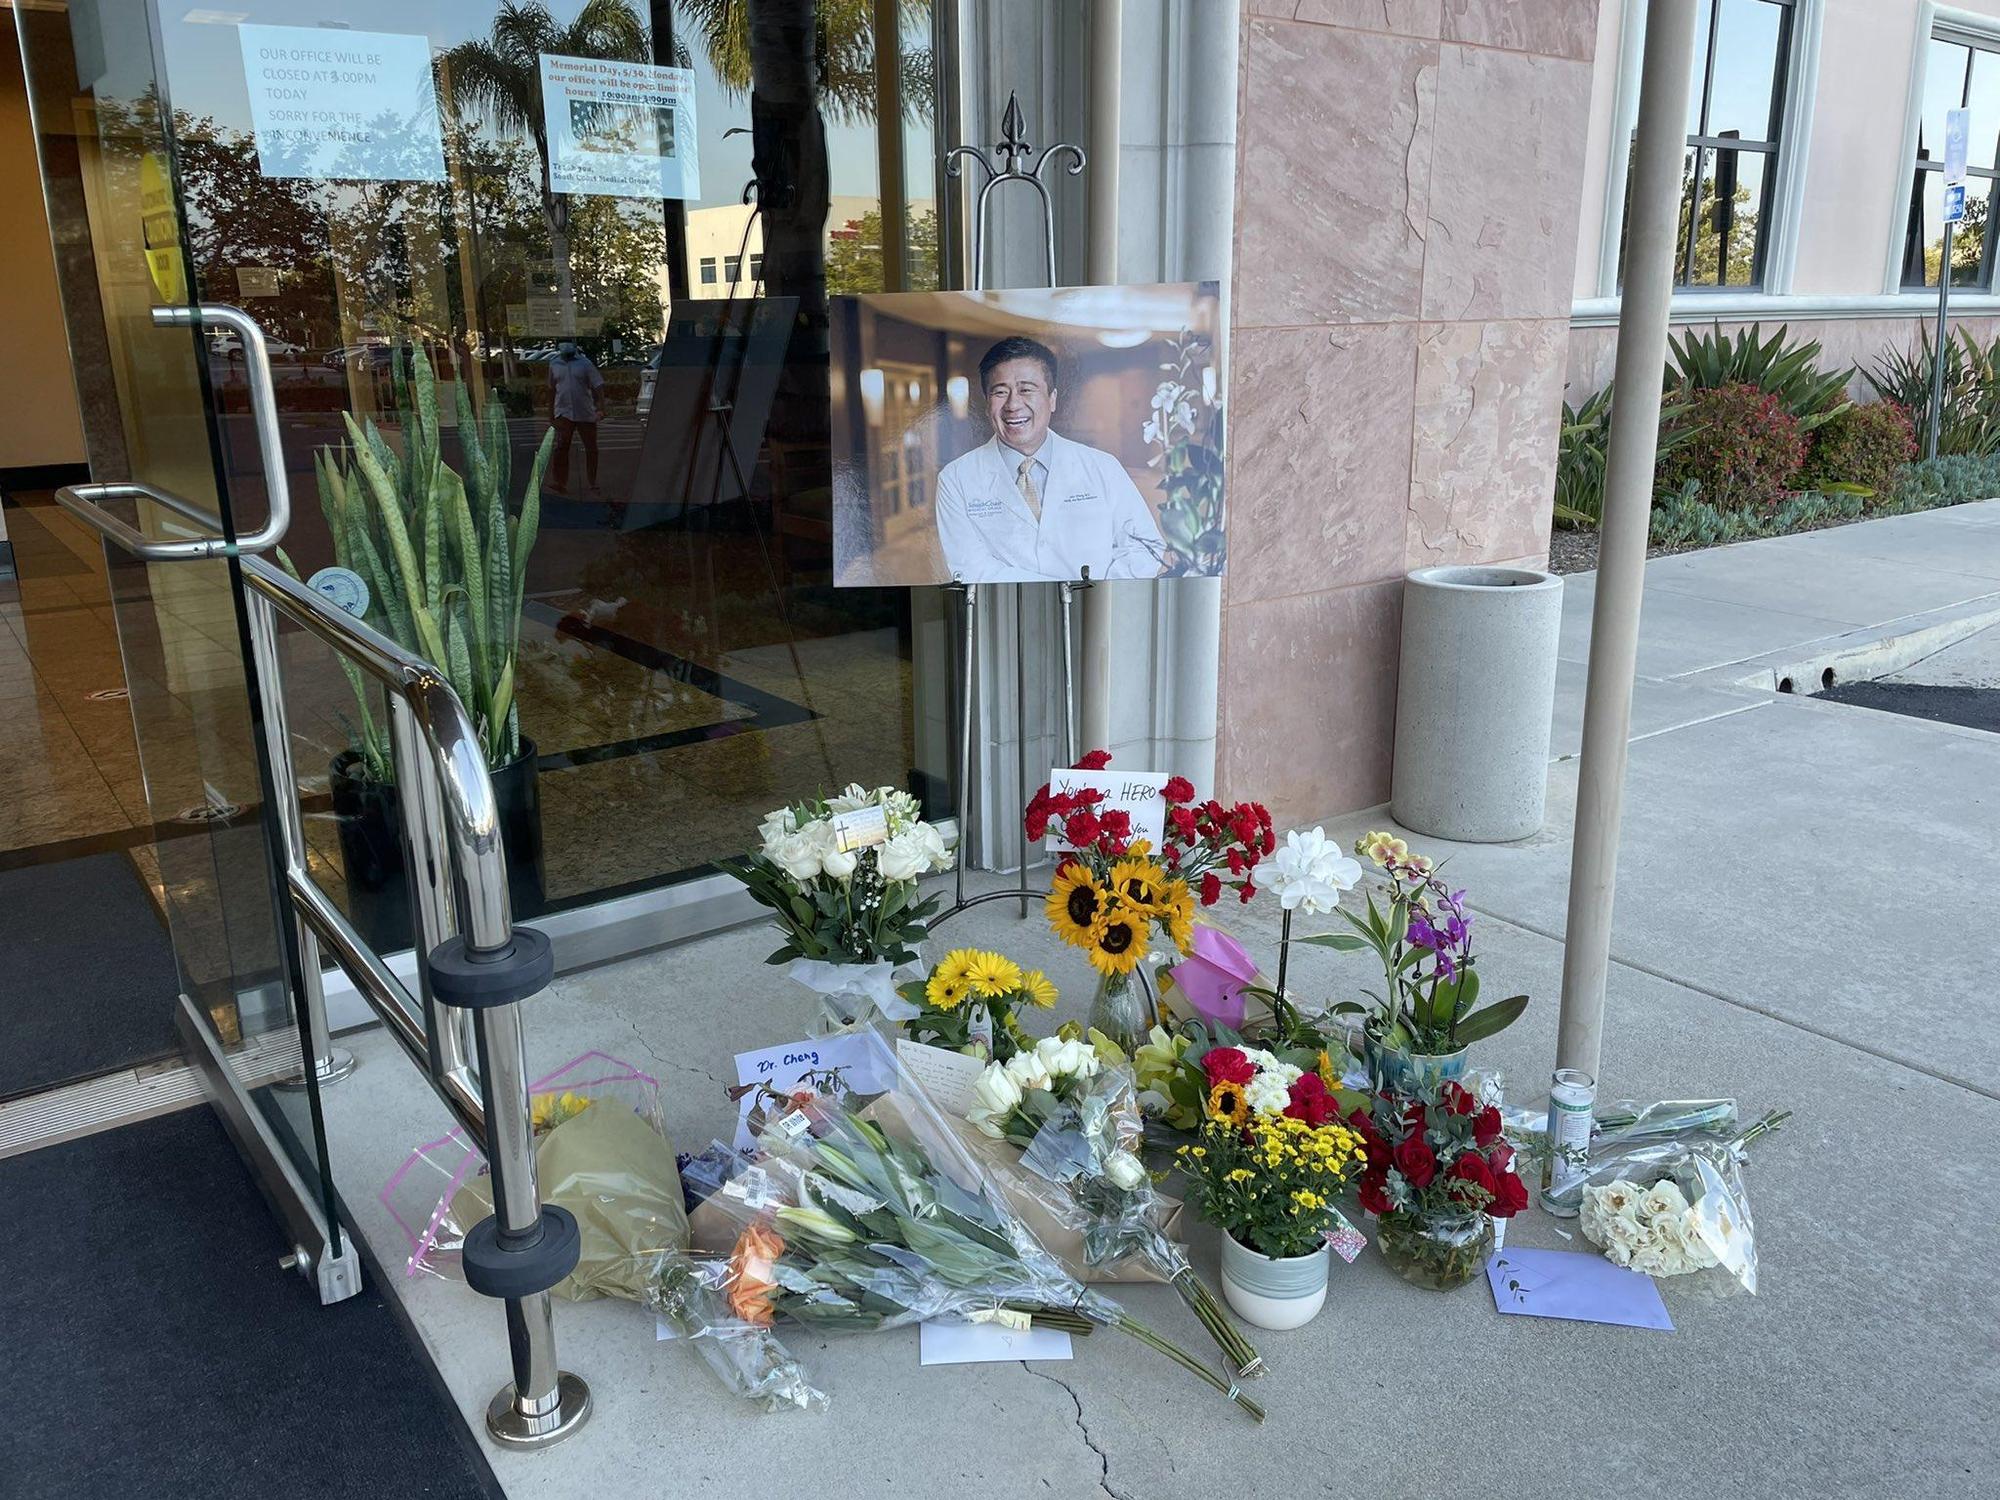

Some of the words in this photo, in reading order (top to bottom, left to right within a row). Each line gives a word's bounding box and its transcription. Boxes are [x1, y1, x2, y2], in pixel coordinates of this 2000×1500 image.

[260, 48, 287, 60] OUR
[290, 49, 332, 62] OFFICE
[334, 51, 364, 64] WILL
[366, 54, 382, 65] BE
[262, 68, 310, 81] CLOSED
[313, 70, 328, 82] AT
[550, 60, 598, 73] Memorial
[600, 64, 621, 76] Day,
[548, 74, 565, 82] our
[568, 74, 596, 85] office
[599, 78, 618, 88] will
[620, 79, 631, 89] be
[633, 82, 656, 93] open
[657, 82, 691, 94] limit
[265, 87, 308, 100] TODAY
[564, 86, 597, 97] hours:
[268, 110, 308, 121] SORRY
[312, 111, 336, 122] FOR
[339, 112, 361, 124] THE
[271, 129, 371, 143] INCONVENIENCE
[1120, 781, 1157, 801] HERO
[757, 1060, 778, 1074] Dr.
